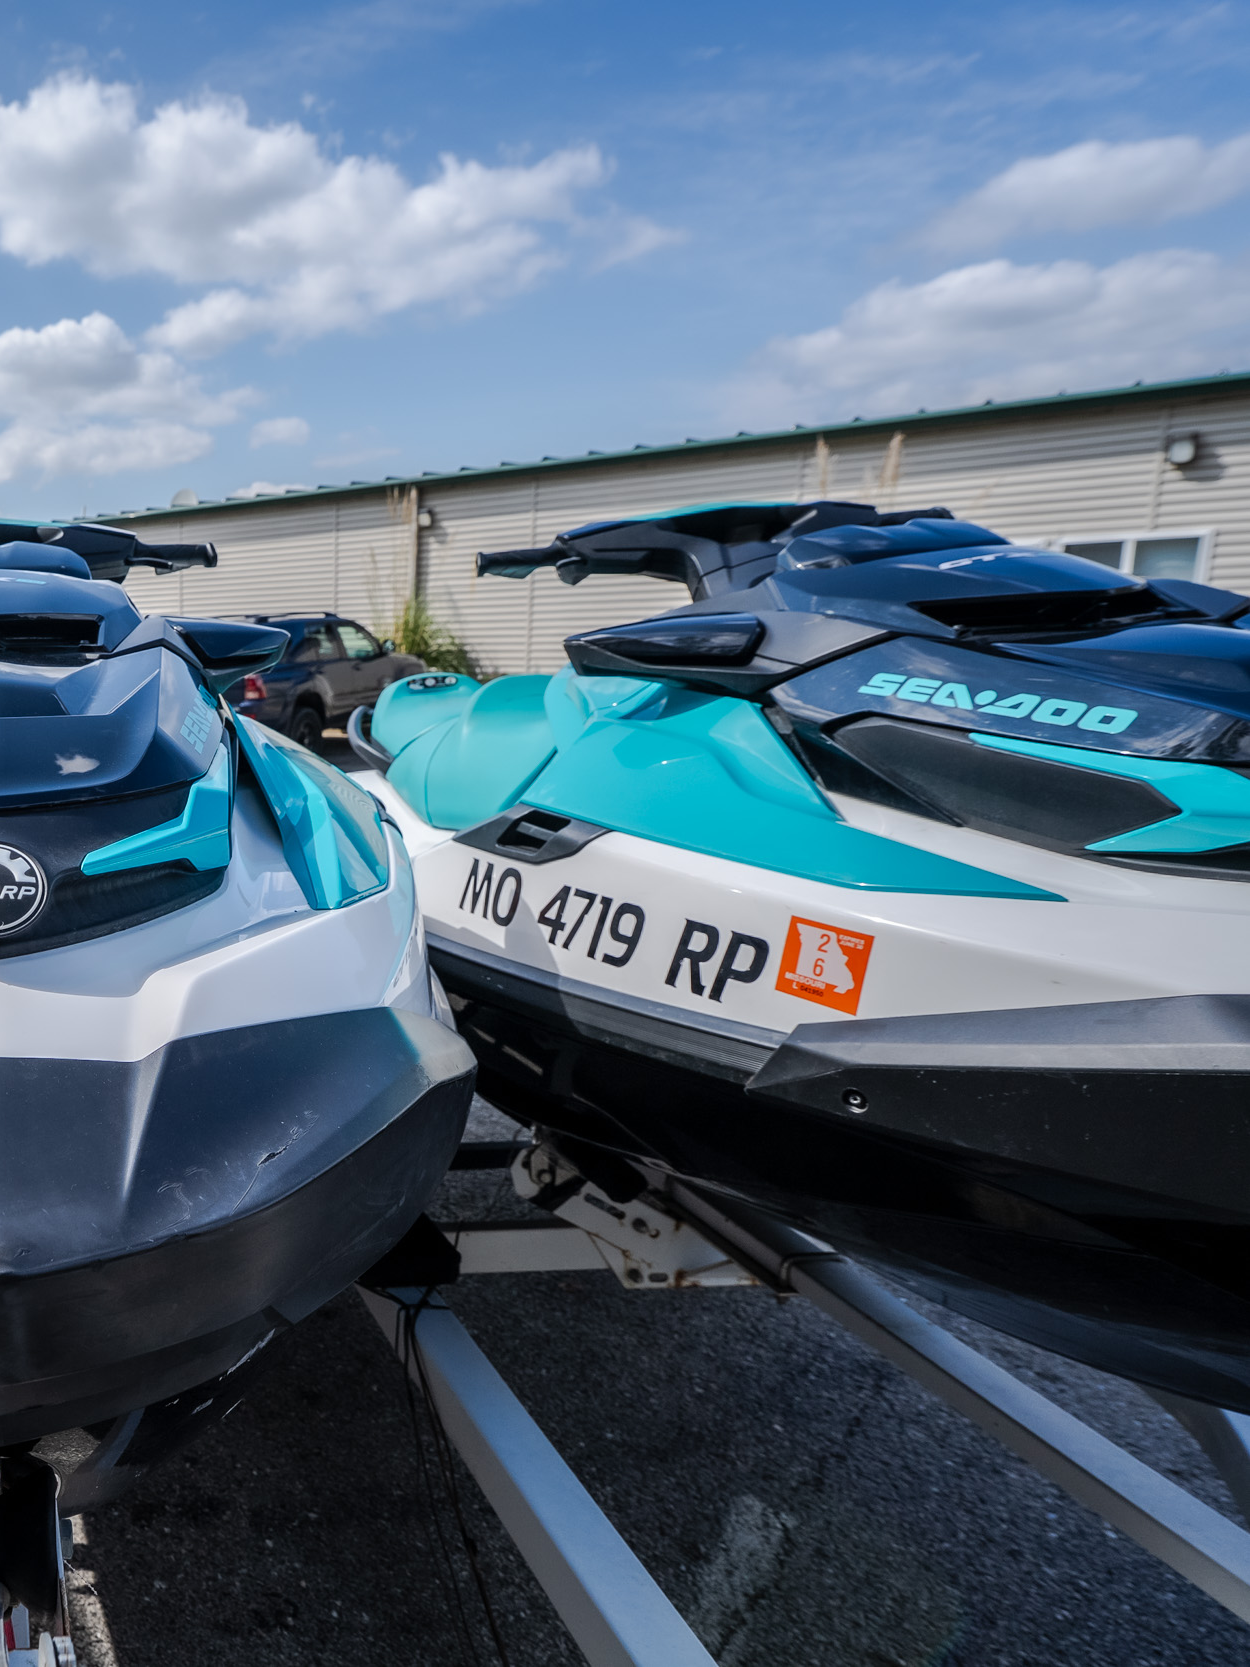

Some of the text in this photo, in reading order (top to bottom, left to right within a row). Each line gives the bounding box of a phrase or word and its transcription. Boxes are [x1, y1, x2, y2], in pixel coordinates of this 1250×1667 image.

[458, 857, 770, 1004] MO 4719 RP
[817, 933, 831, 953] 2
[812, 957, 826, 977] 6
